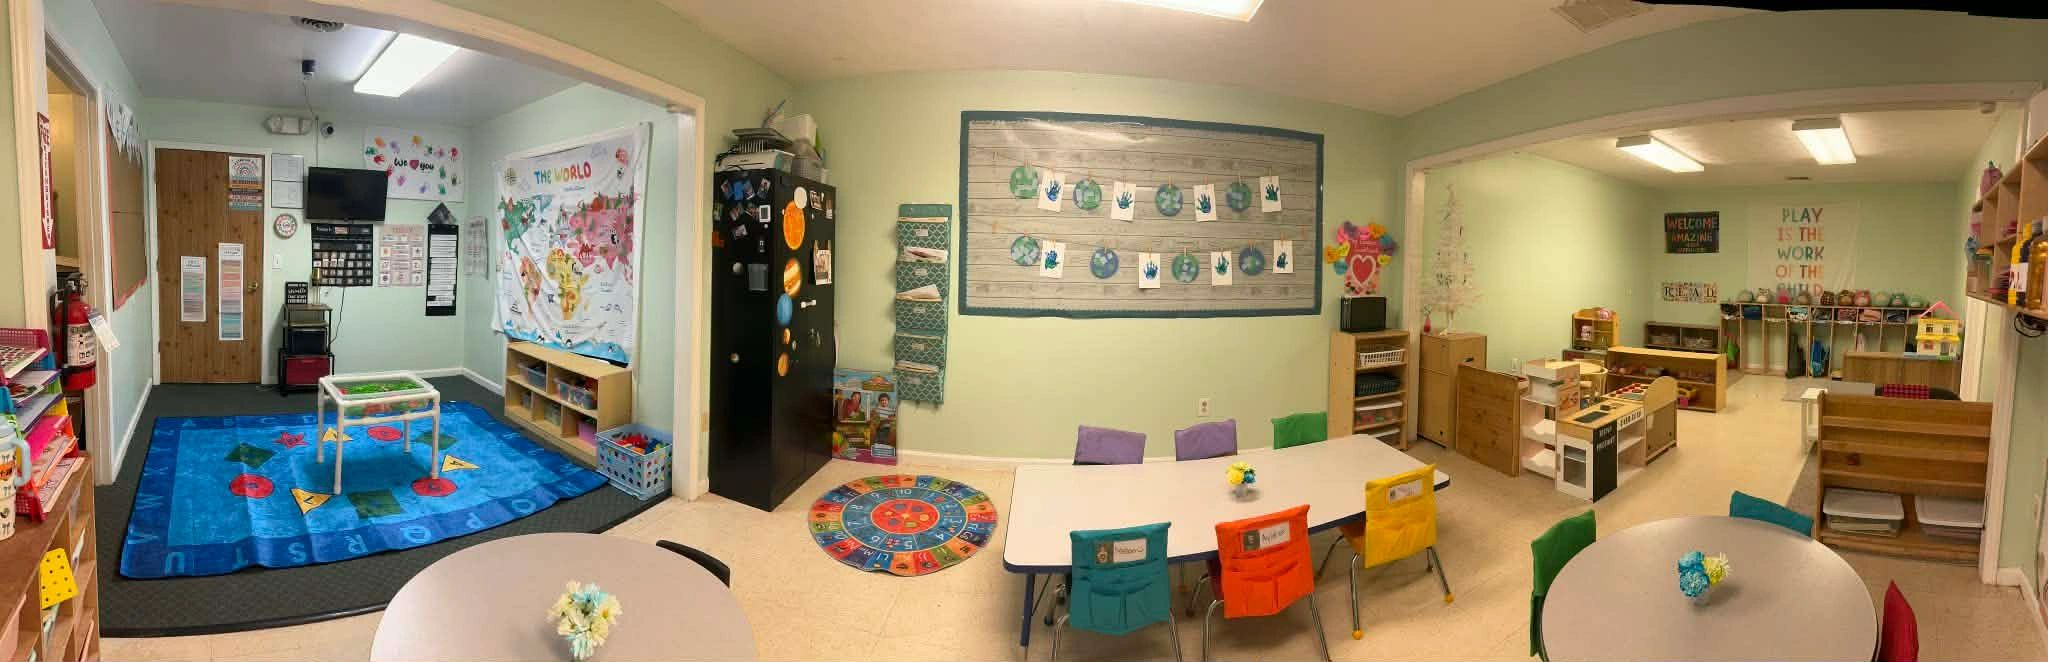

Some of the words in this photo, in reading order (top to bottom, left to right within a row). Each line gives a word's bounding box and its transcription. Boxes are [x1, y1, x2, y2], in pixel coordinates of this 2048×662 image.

[419, 161, 435, 171] you
[533, 169, 552, 185] THE
[553, 161, 592, 182] WORLD
[1667, 216, 1718, 230] WELCOME
[1782, 207, 1823, 224] PLAY
[1776, 226, 1792, 241] IS
[1800, 226, 1824, 242] THE
[1778, 246, 1824, 261] WORK
[1776, 264, 1792, 279] OF
[1800, 264, 1824, 280] THE
